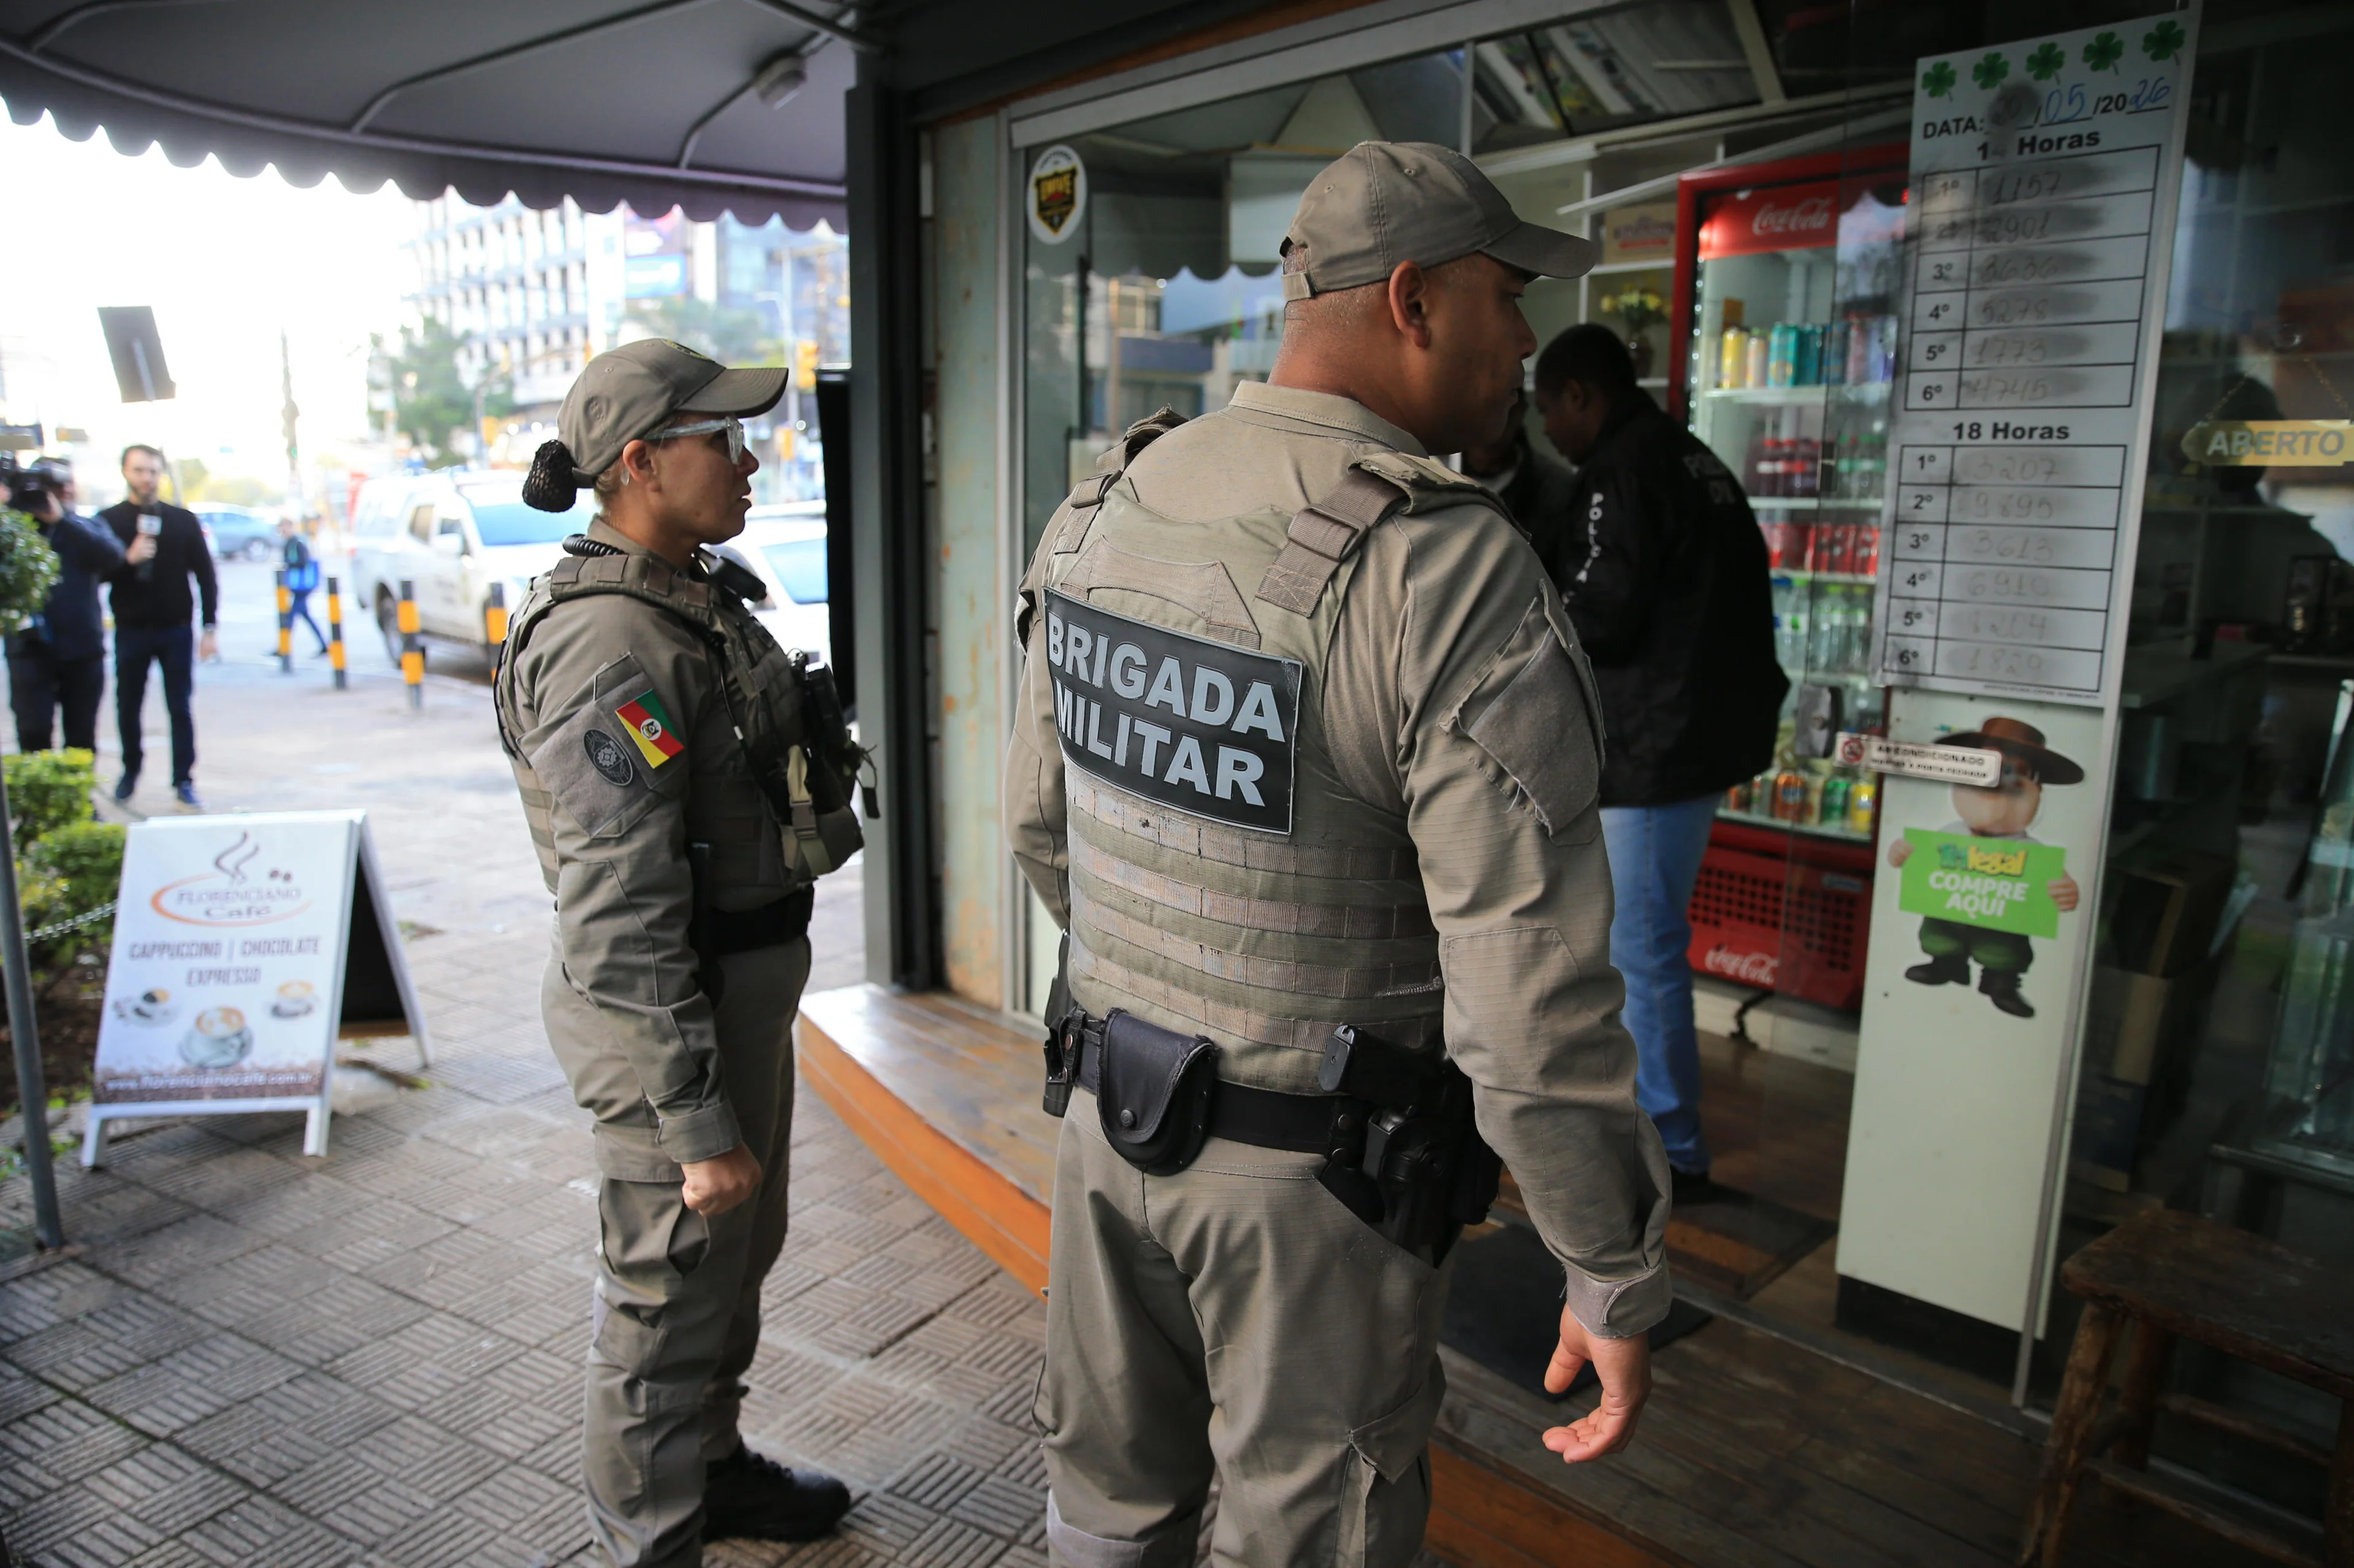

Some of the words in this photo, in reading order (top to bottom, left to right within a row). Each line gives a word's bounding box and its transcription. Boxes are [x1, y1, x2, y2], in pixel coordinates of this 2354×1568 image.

[1922, 116, 1984, 139] DATA:
[2017, 131, 2101, 155] Horas
[1751, 197, 1835, 236] Coca-Cola
[1952, 422, 1983, 440] 18
[1991, 422, 2070, 440] Horas
[2206, 430, 2345, 457] ABERTO
[1048, 611, 1286, 743] BRIGADA
[1054, 679, 1265, 807] MILITAR
[1928, 870, 2031, 902] COMPRE
[1945, 892, 2007, 919] AQUI
[128, 939, 223, 961] CAPPUCCINO
[240, 935, 322, 958] CHOCOLATE
[186, 966, 262, 988] EXPRESSO
